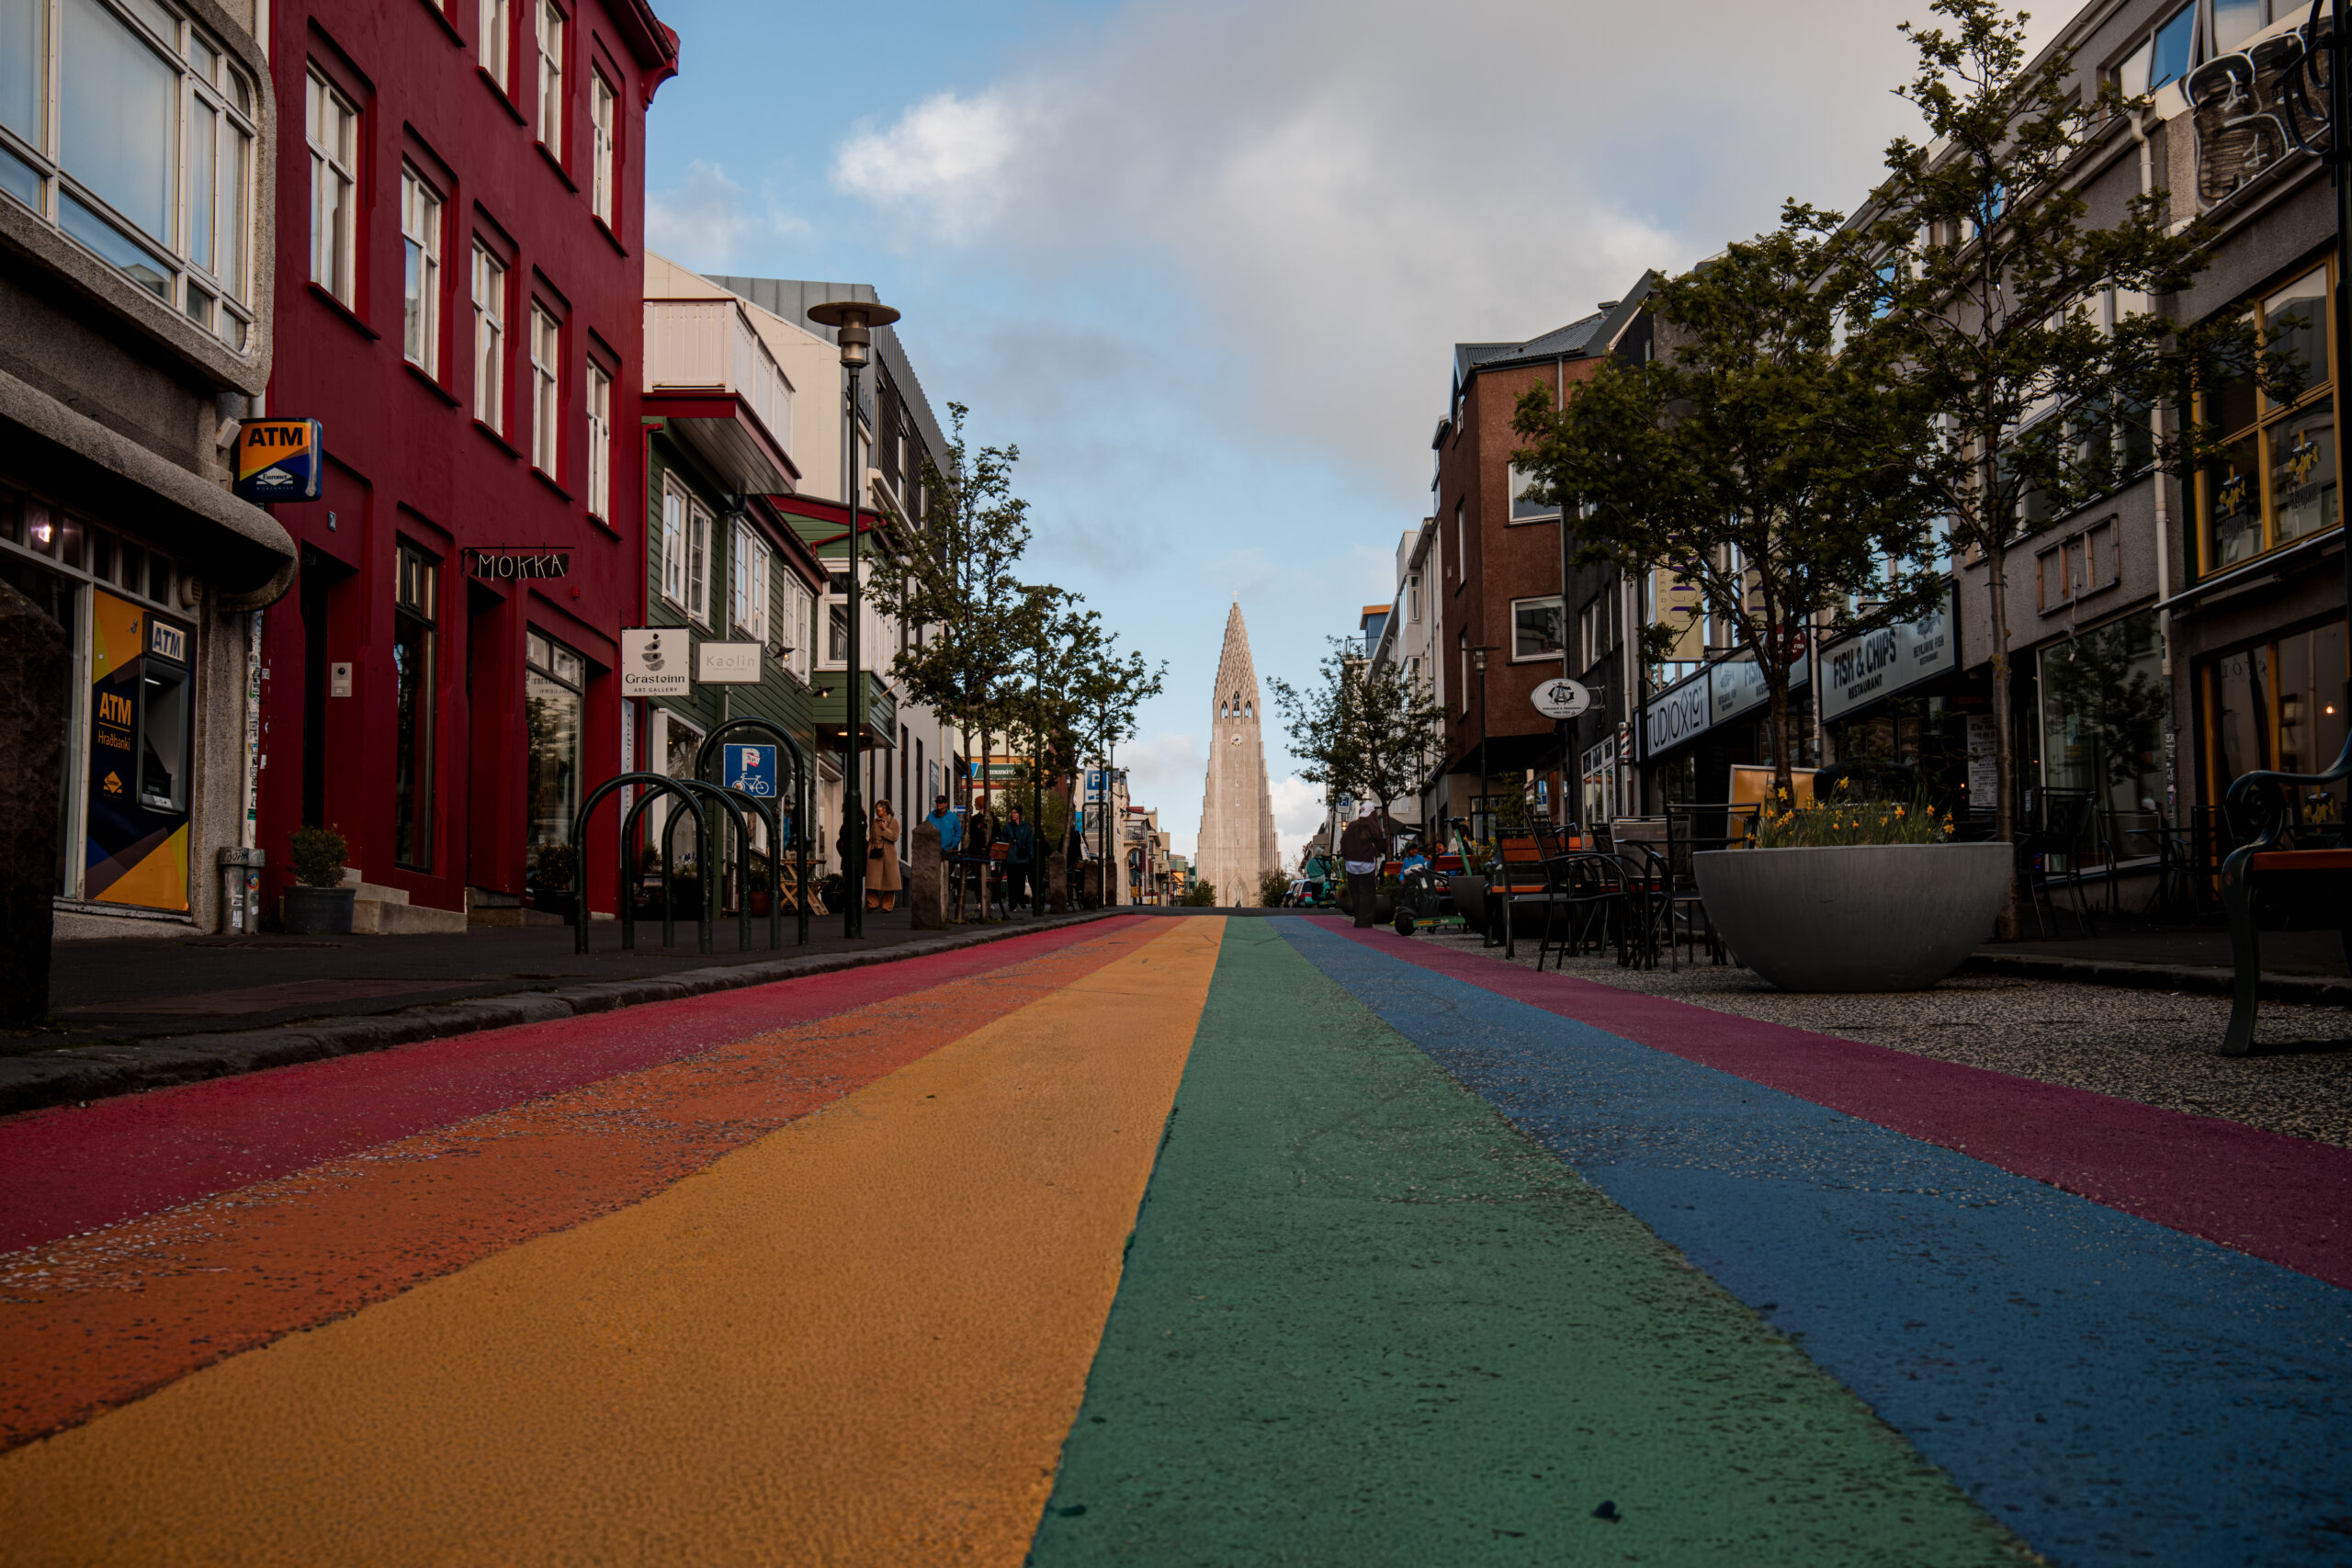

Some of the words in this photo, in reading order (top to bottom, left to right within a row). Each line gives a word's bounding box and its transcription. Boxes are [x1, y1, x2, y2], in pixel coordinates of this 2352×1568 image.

[248, 427, 302, 446] ATM
[479, 554, 565, 581] MOKKA
[153, 626, 181, 658] ATM
[1935, 634, 1944, 648] FISH
[707, 653, 754, 667] Kaolin
[1834, 648, 1854, 689] FISH
[1857, 646, 1864, 678] &
[1866, 627, 1896, 673] CHIPS
[625, 673, 685, 683] Grásteinn
[1849, 673, 1883, 700] RESTAURANT
[99, 692, 131, 726] ATM
[1646, 701, 1679, 751] TUDIO
[97, 729, 130, 750] Hraðbanki
[742, 748, 761, 772] P
[1091, 773, 1102, 787] P
